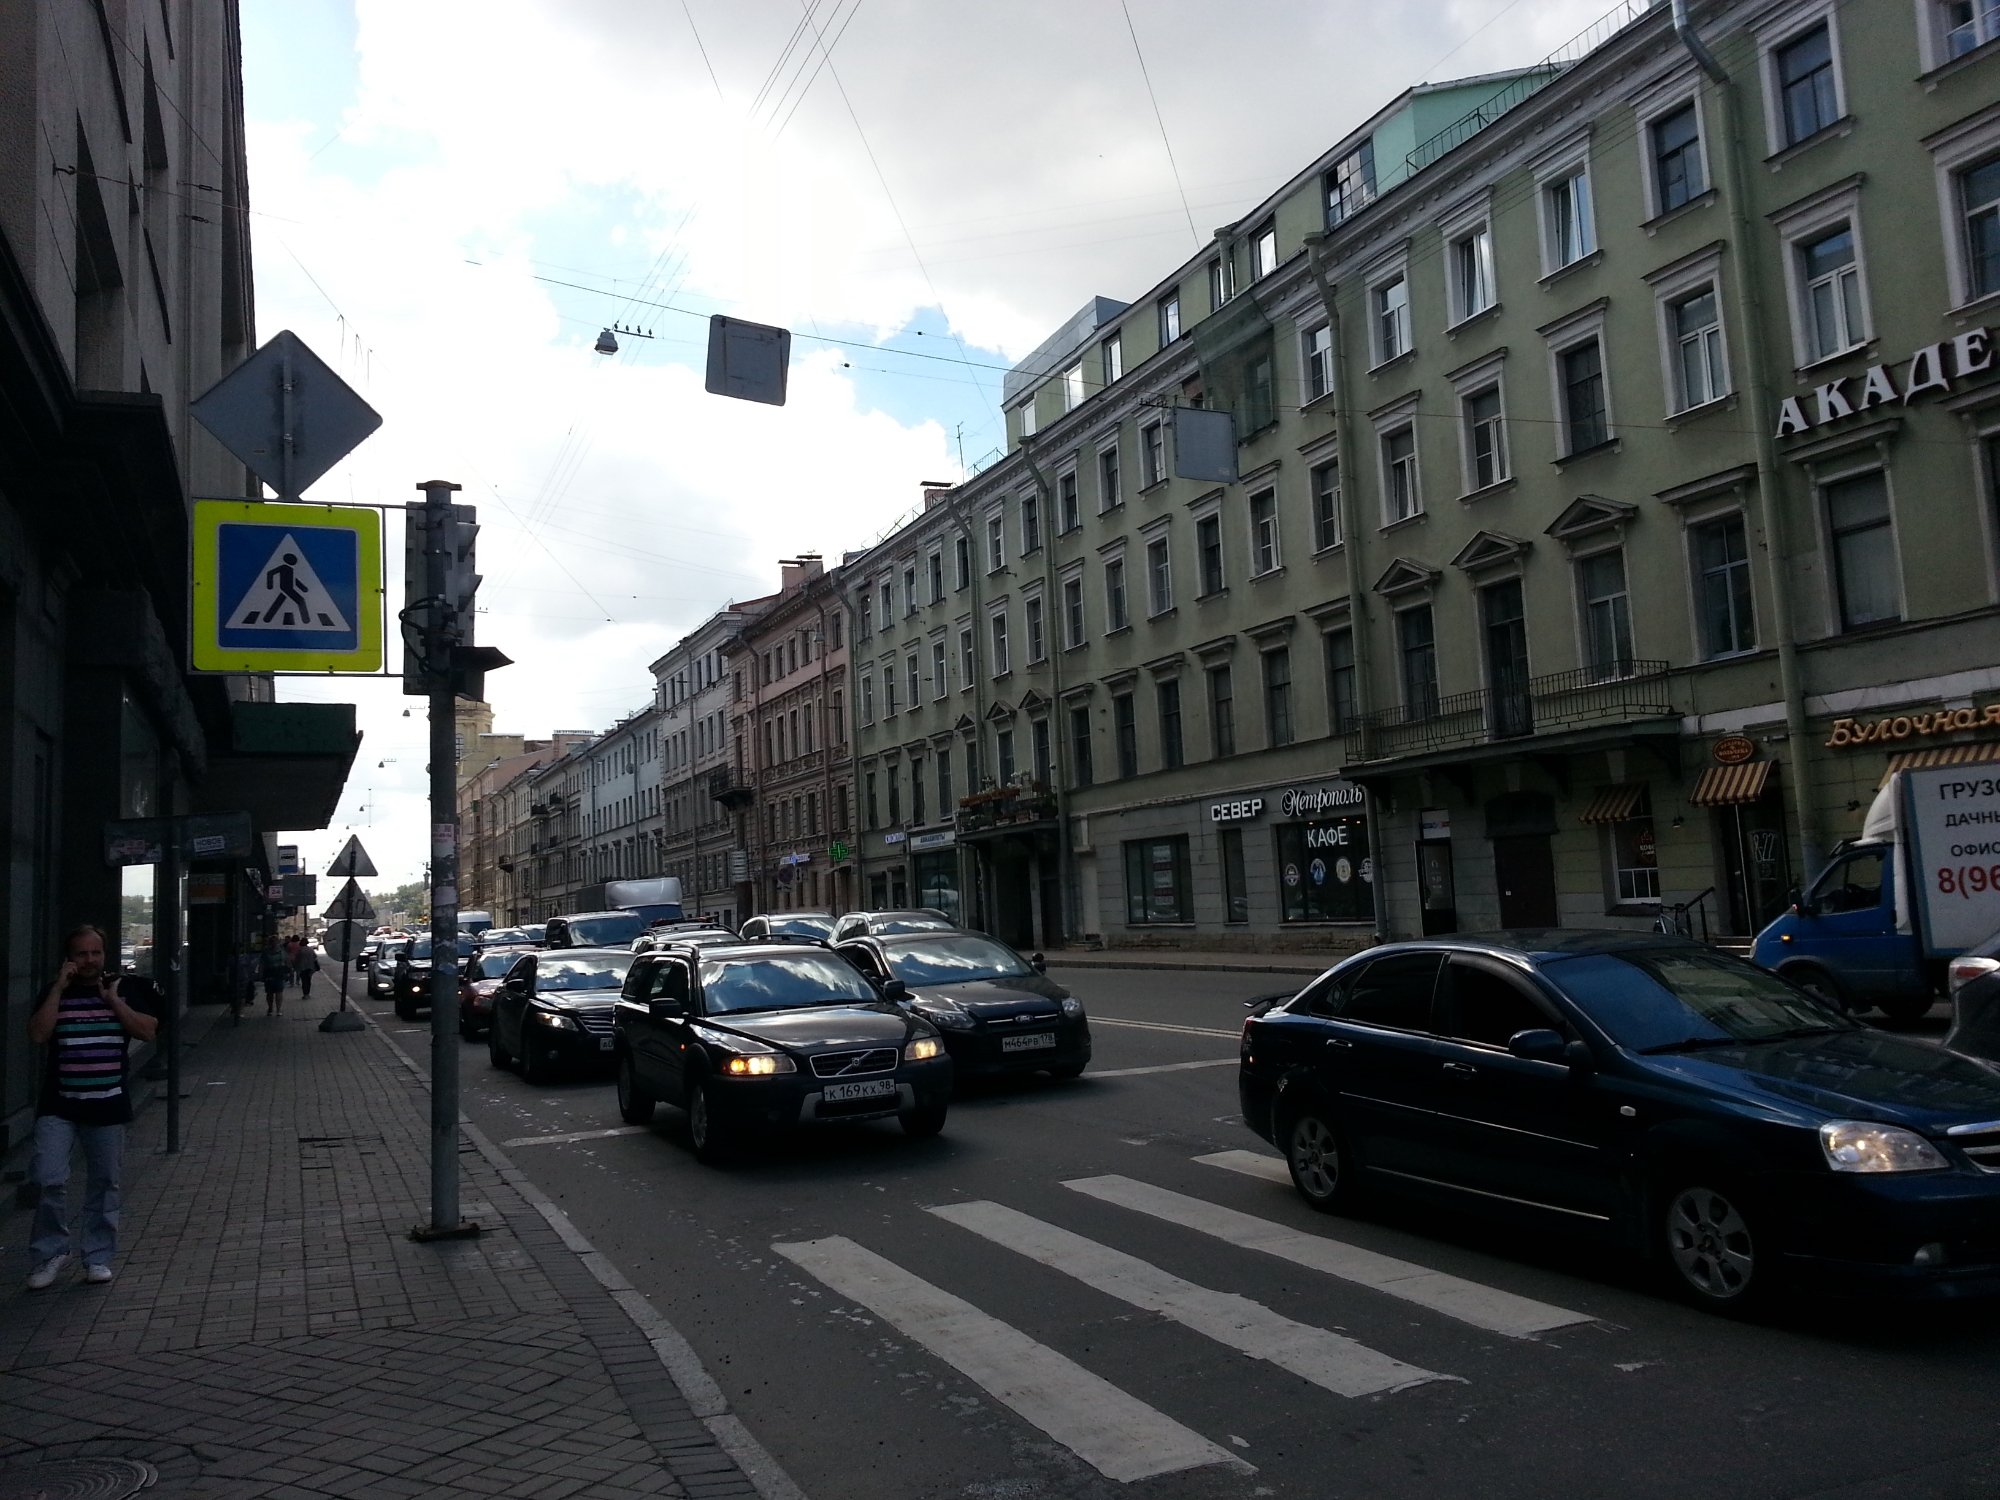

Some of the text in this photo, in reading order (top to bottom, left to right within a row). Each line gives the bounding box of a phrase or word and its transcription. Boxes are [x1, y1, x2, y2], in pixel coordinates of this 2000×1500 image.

[1774, 327, 1993, 439] АКАДЕ
[1825, 704, 2000, 747] Булочная
[1211, 798, 1263, 821] СЕВЕР
[1307, 826, 1348, 848] КАФЕ
